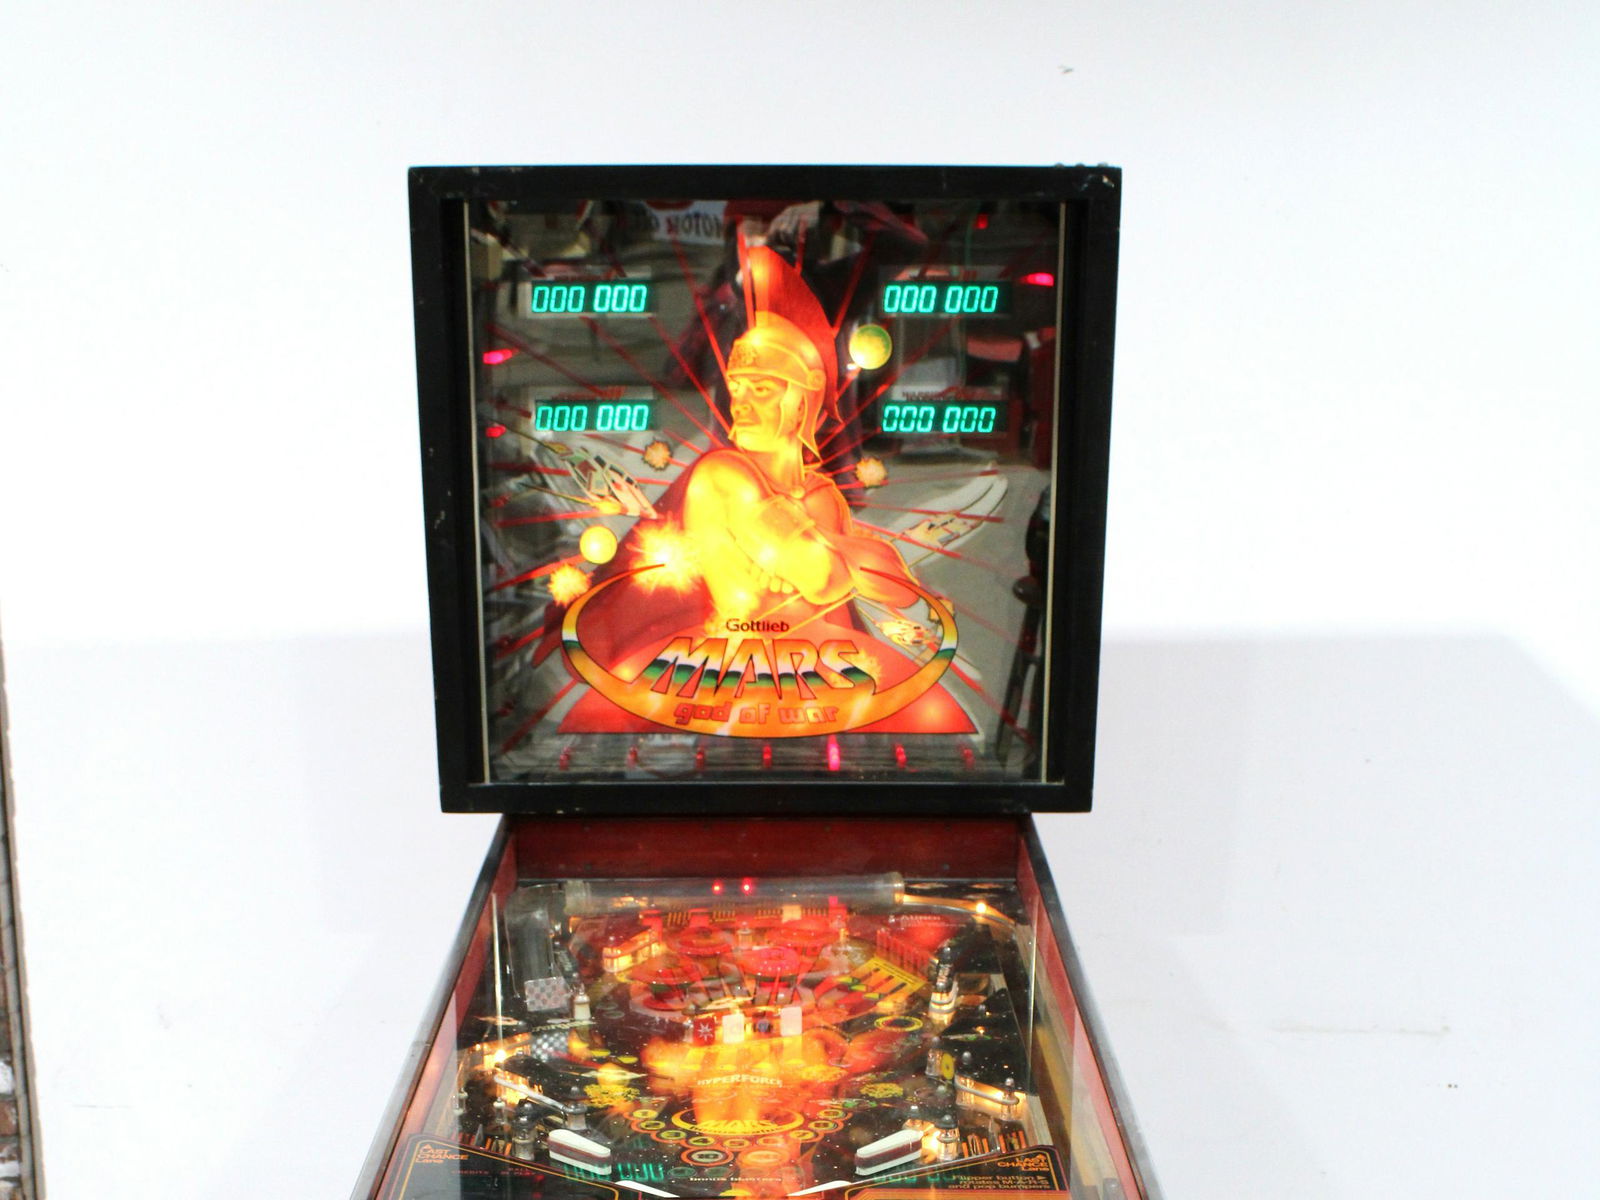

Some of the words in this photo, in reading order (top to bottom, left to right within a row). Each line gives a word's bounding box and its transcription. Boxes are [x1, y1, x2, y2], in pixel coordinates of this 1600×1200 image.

[532, 285, 585, 313] 000
[593, 284, 647, 313] 000
[884, 285, 937, 313] 000
[944, 285, 999, 313] 000
[535, 405, 588, 432] 000
[596, 404, 649, 432] 000
[882, 405, 935, 432] 000
[942, 406, 996, 433] 000
[725, 617, 790, 633] Gottlieb
[632, 636, 877, 700] MARS
[673, 702, 732, 726] god
[738, 703, 771, 725] of
[777, 705, 840, 725] war
